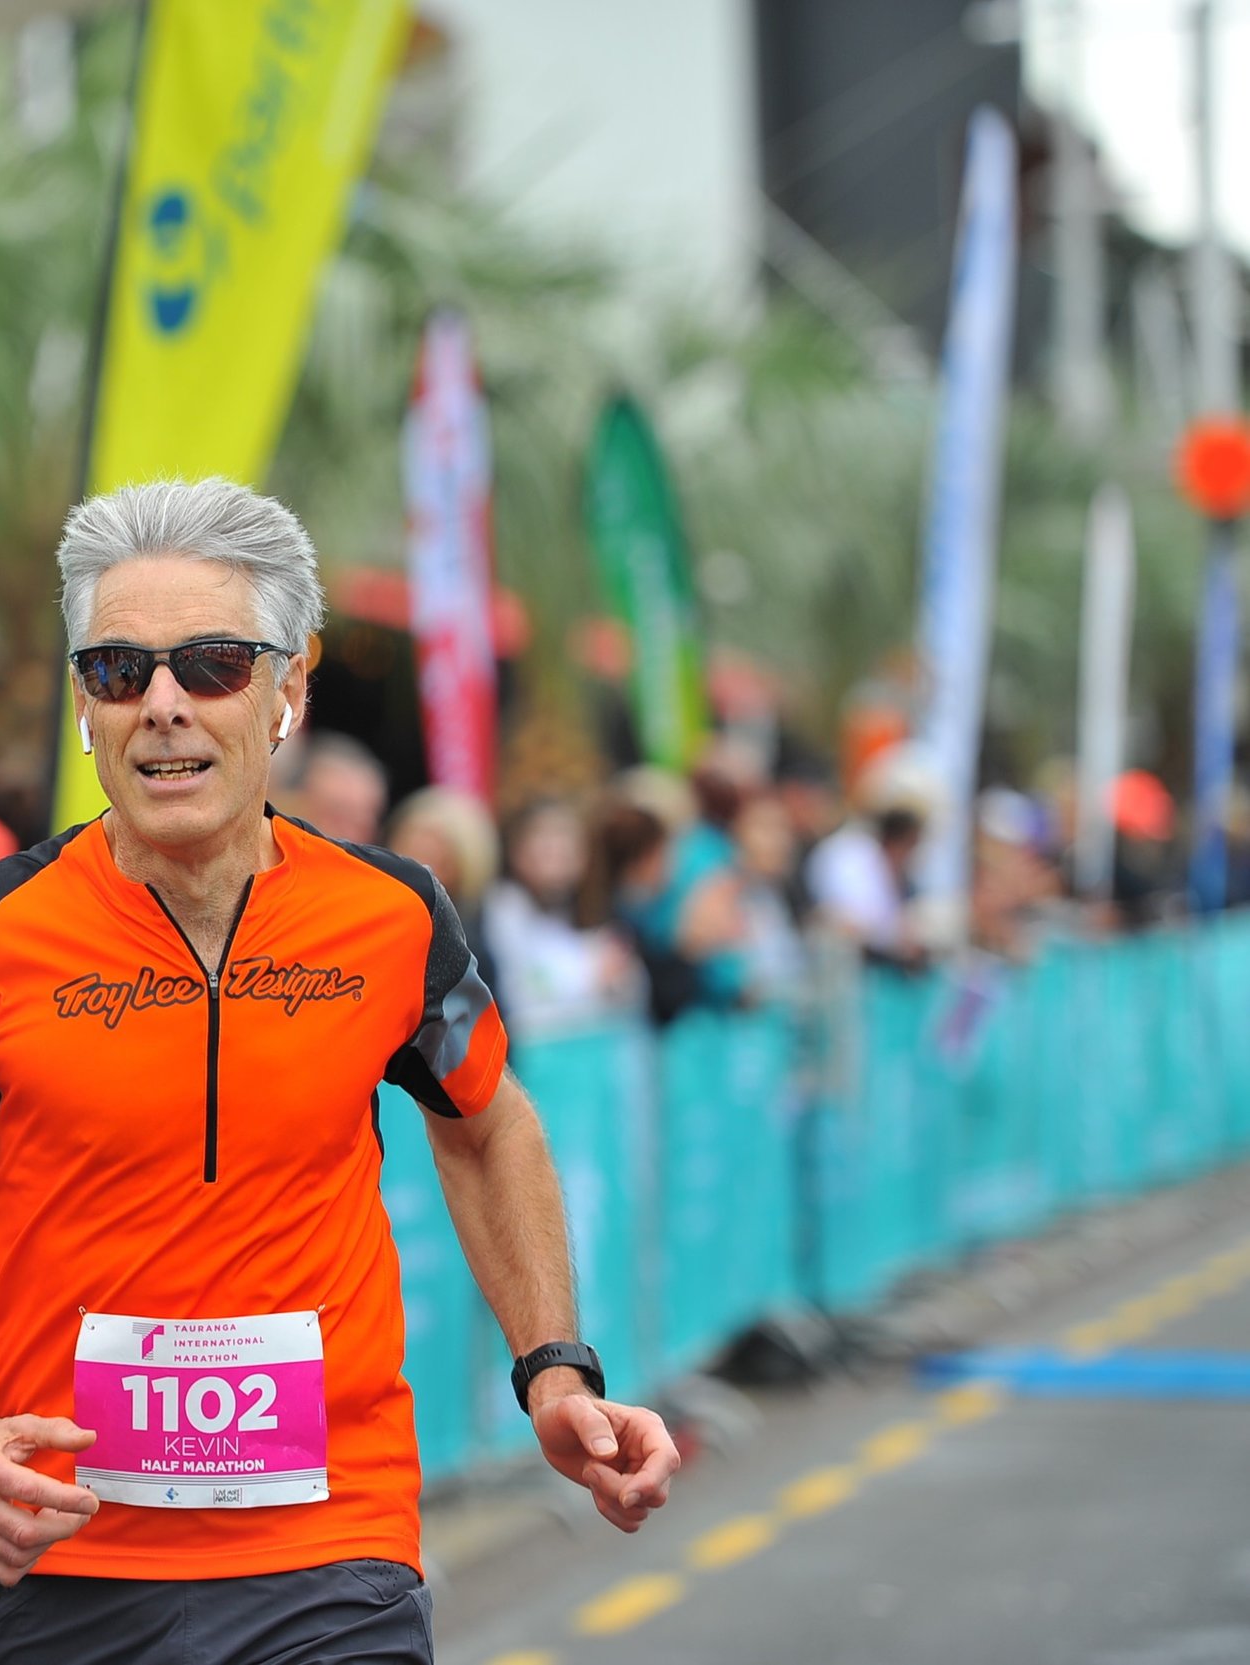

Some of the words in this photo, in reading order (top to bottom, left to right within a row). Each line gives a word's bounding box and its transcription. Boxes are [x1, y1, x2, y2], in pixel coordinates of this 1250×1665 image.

[53, 973, 133, 1030] Troy
[132, 966, 205, 1010] Lee
[225, 956, 365, 1018] Designs
[174, 1323, 237, 1333] TAURANGA
[174, 1336, 265, 1348] INTERNATIONAL
[174, 1353, 239, 1363] MARATHON
[121, 1373, 279, 1434] 1102
[164, 1436, 240, 1457] KEVIN
[141, 1459, 180, 1472] HALF
[183, 1459, 266, 1473] MARATHON
